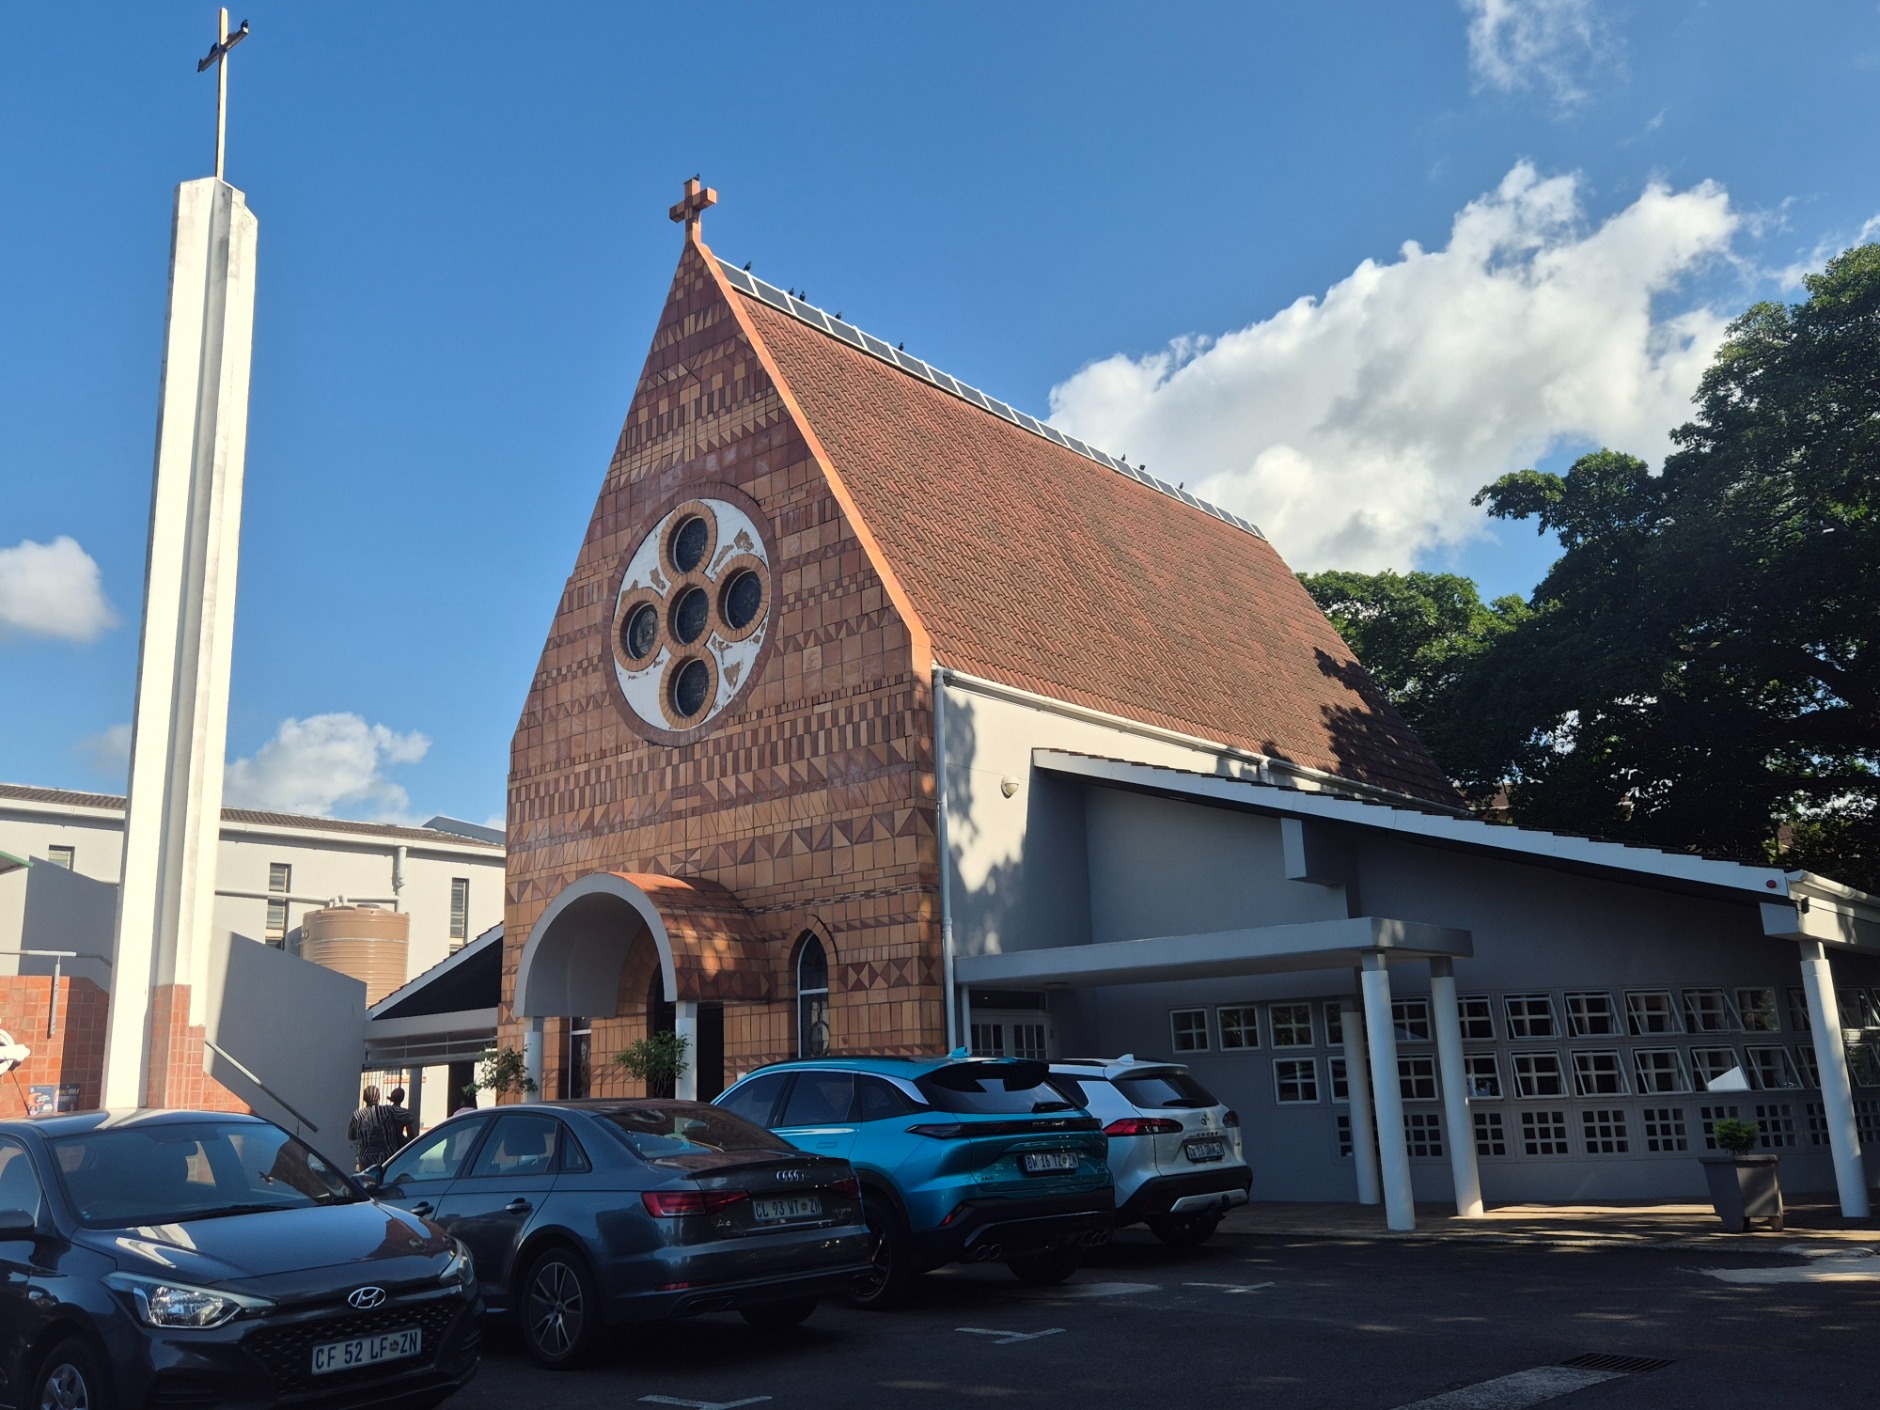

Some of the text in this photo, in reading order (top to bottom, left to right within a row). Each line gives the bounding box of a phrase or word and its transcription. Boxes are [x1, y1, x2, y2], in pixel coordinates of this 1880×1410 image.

[755, 1202, 769, 1218] CL
[772, 1200, 785, 1216] 93
[808, 1198, 821, 1213] ZN
[315, 1331, 418, 1369] CF 52 LF ZN
